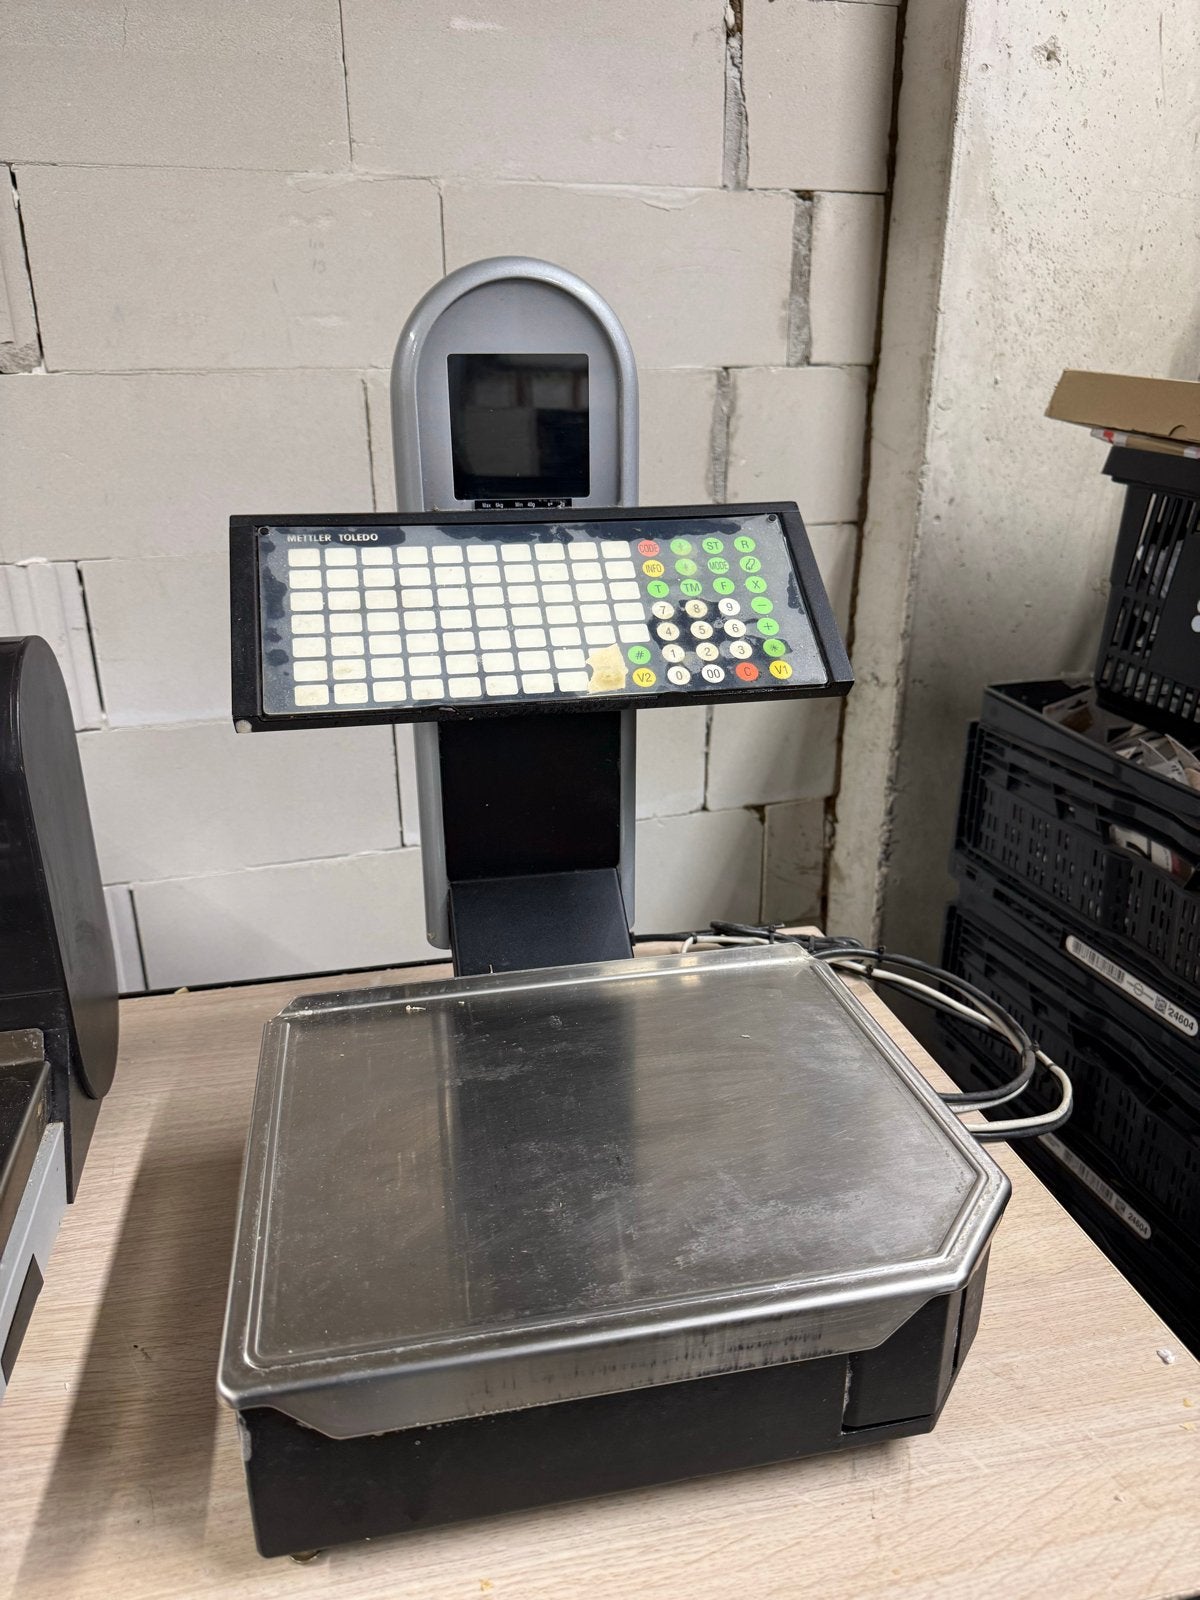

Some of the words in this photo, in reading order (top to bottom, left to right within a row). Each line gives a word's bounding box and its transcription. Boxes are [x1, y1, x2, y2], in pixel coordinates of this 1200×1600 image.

[287, 534, 331, 542] METTLER
[338, 533, 378, 542] TOLEDO
[638, 543, 658, 553] CODE
[706, 541, 719, 551] ST
[741, 540, 749, 549] R
[645, 563, 662, 573] INFO
[709, 560, 728, 571] MODE
[654, 584, 662, 594] T
[683, 582, 700, 593] TM
[720, 581, 727, 590] F
[659, 605, 666, 615] 7
[693, 603, 701, 613] 8
[726, 602, 733, 612] 9
[665, 627, 672, 636] 4
[698, 625, 706, 635] 5
[732, 623, 739, 633] 6
[635, 650, 645, 660] #
[670, 648, 676, 658] 1
[704, 647, 712, 657] 2
[738, 645, 745, 655] 3
[707, 668, 720, 679] 00
[744, 666, 751, 677] C
[775, 664, 788, 675] V1
[638, 672, 652, 683] V2
[675, 670, 683, 681] 0
[1168, 1007, 1195, 1031] 24604
